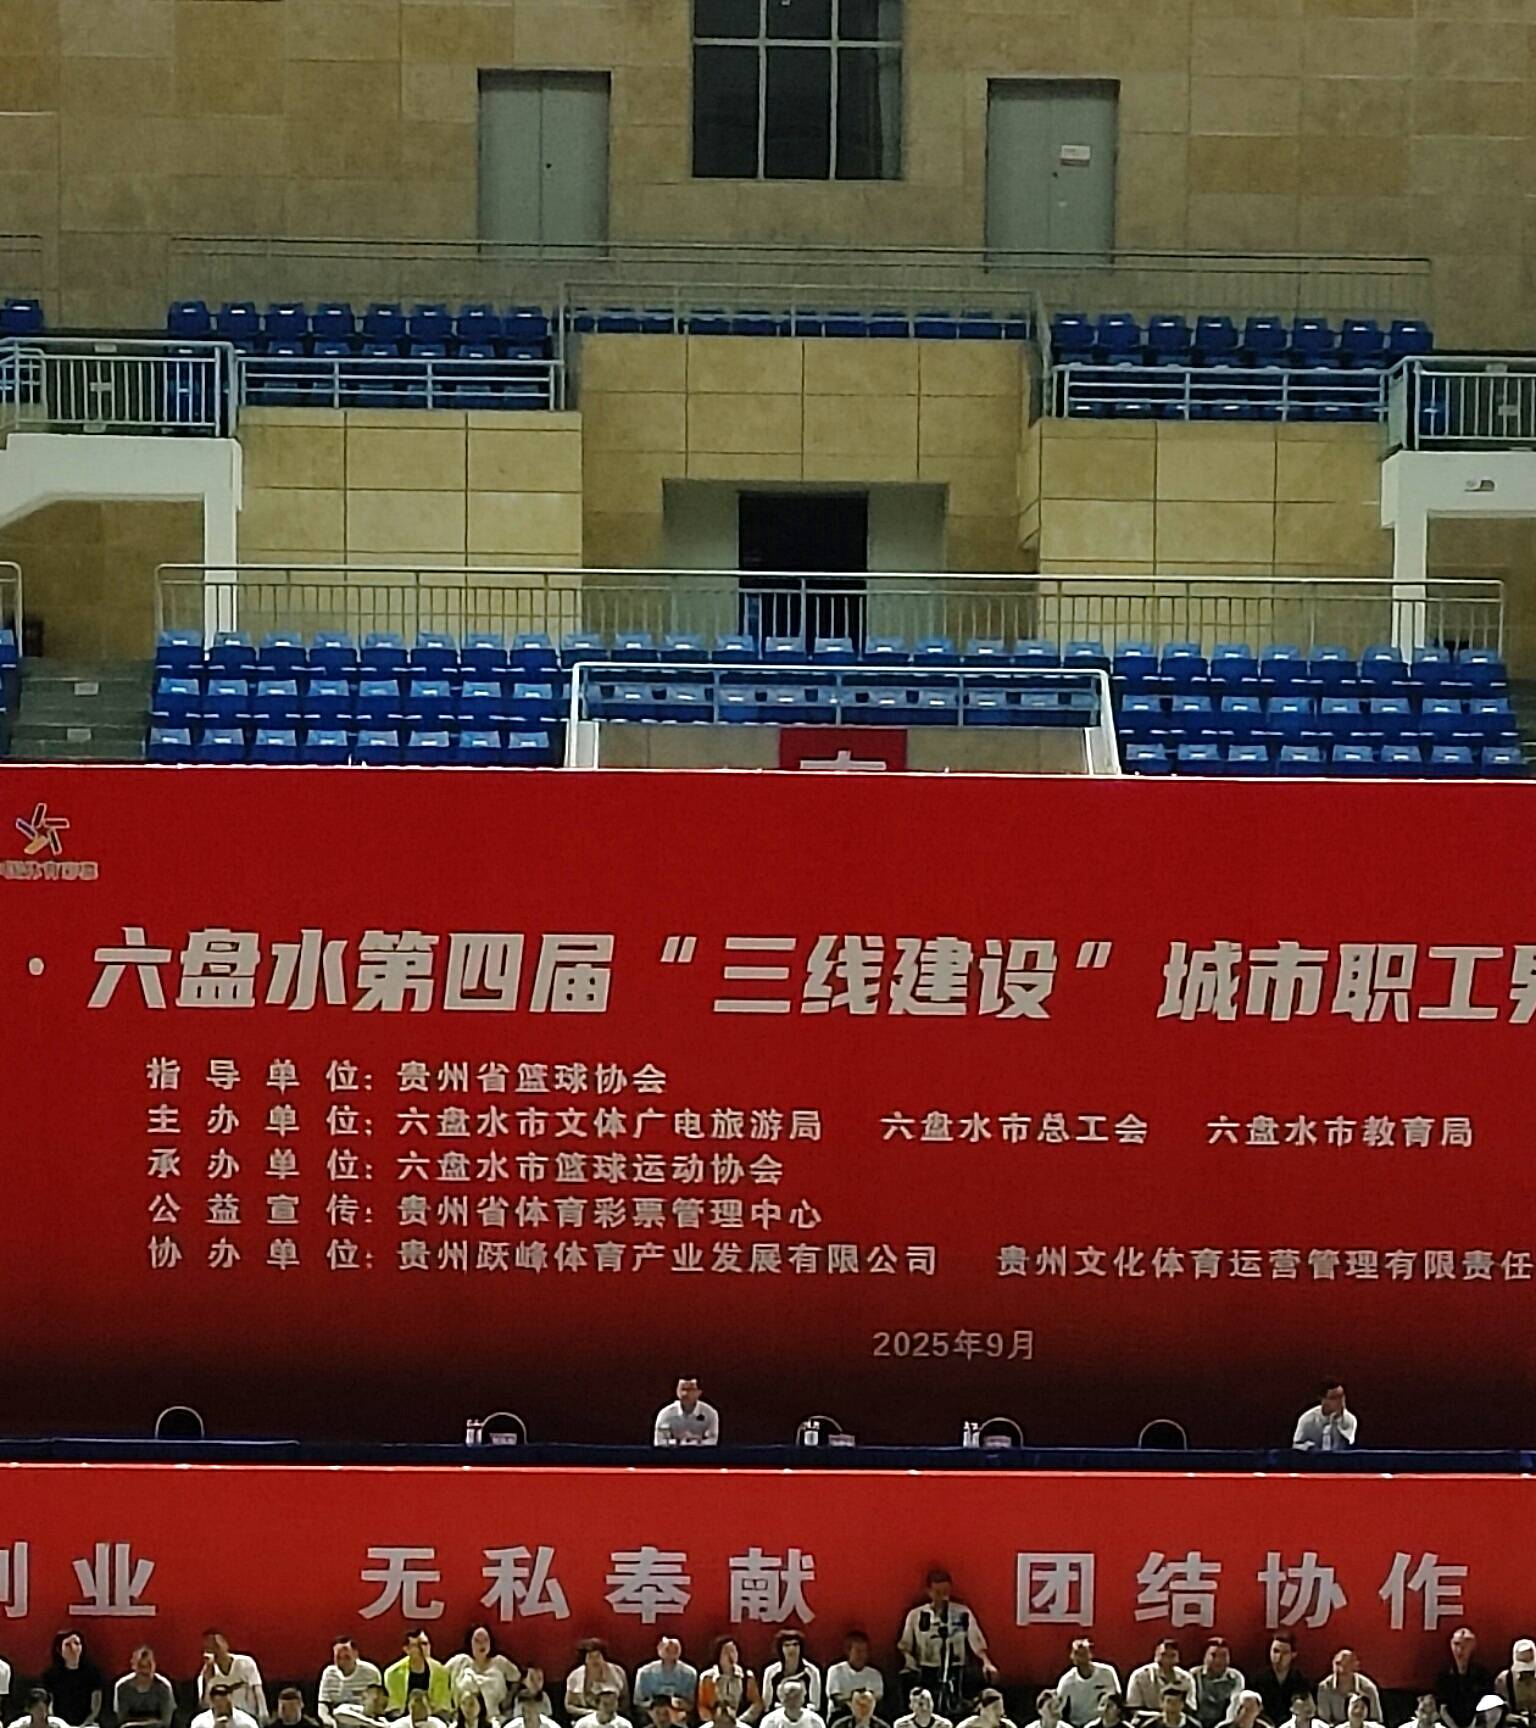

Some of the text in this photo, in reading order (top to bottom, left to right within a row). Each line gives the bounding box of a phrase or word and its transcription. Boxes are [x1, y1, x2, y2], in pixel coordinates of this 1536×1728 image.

[880, 1111, 1150, 1146] 六盘水市总工会
[1206, 1115, 1474, 1149] 六盘水市教育局
[872, 1329, 1036, 1363] 2025年9月
[358, 1545, 818, 1626] 无私奉献
[1015, 1550, 1470, 1630] 团结协作
